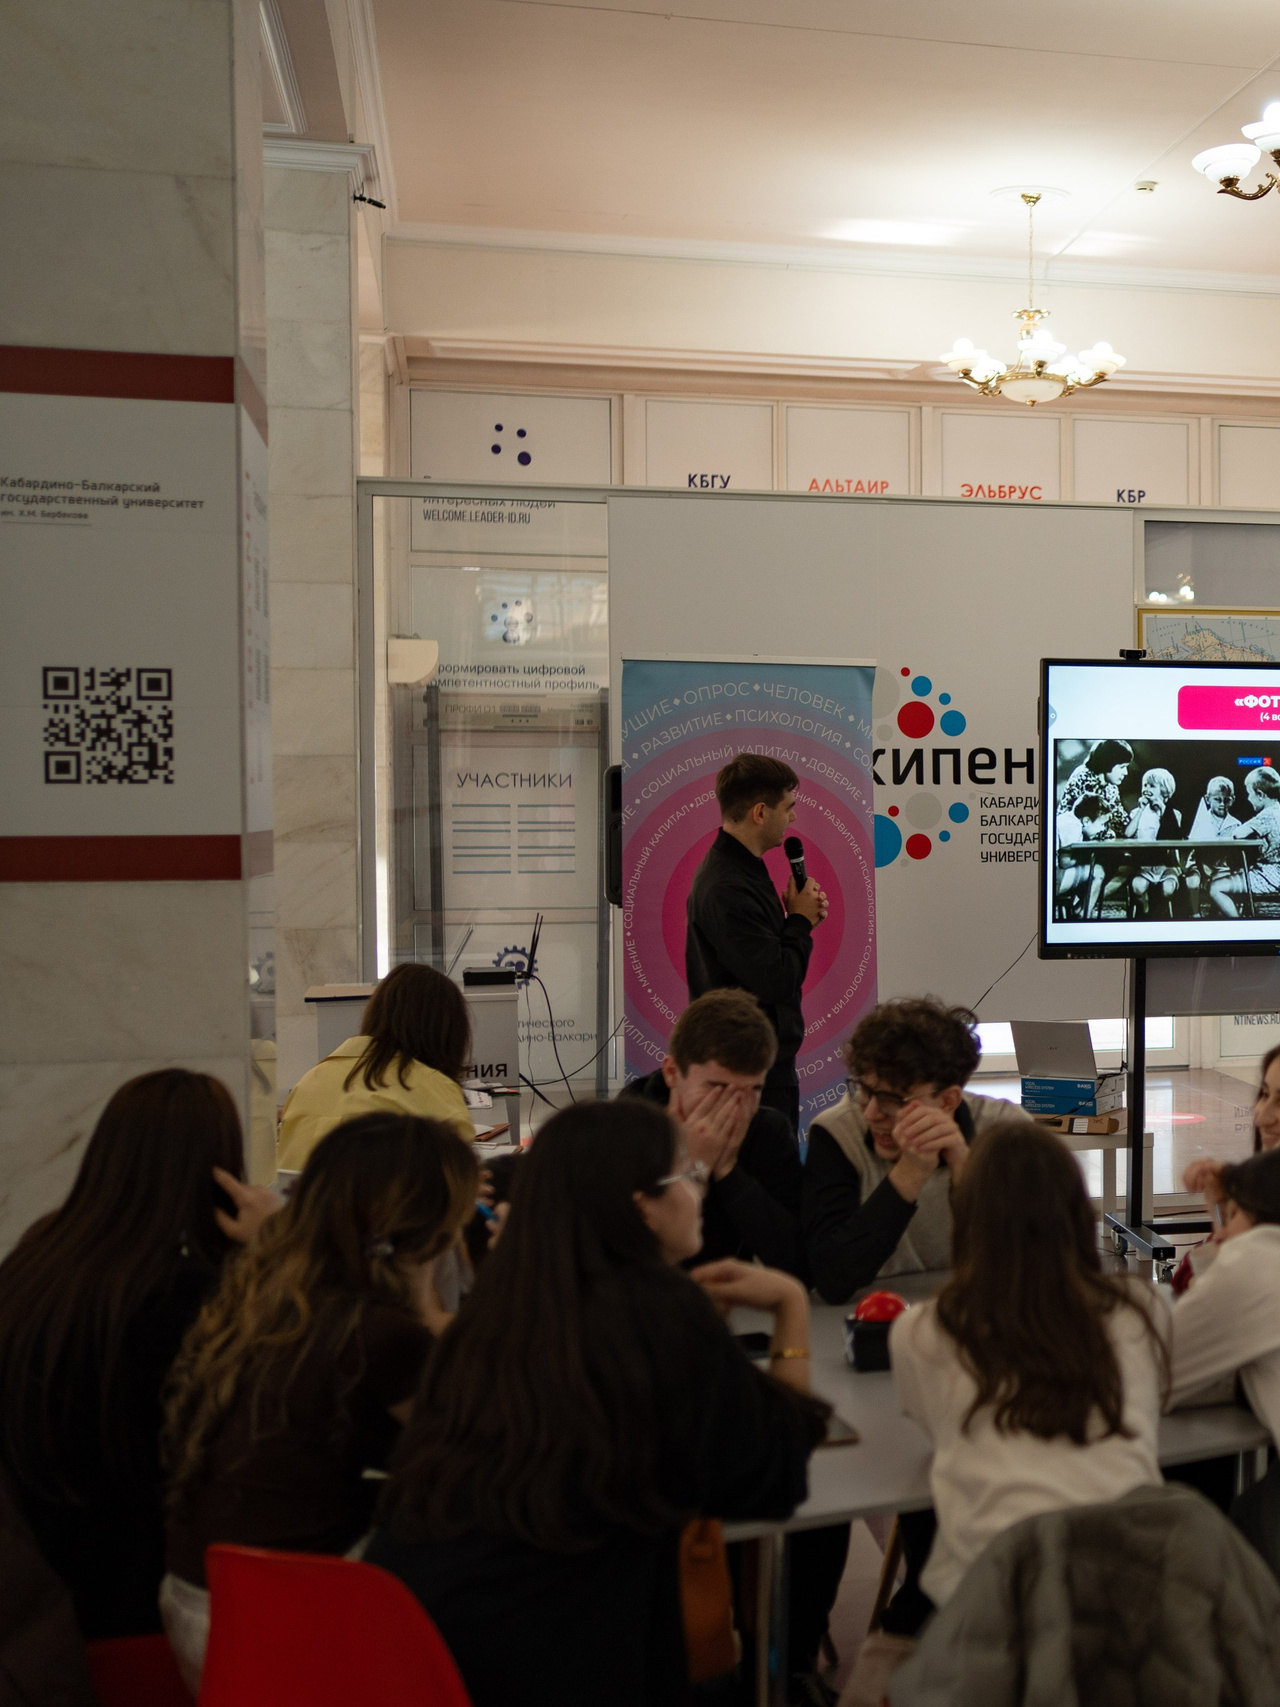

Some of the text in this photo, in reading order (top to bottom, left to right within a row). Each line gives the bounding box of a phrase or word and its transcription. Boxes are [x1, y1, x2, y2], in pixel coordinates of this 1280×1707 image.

[1, 476, 160, 493] Кабардино-Балкарский
[687, 473, 731, 489] КБГУ
[807, 478, 890, 493] АЛЬТАИР
[960, 484, 1043, 500] ЭЛЬБРУС
[1116, 489, 1146, 503] КБР
[1, 492, 204, 509] государственный университет
[423, 509, 531, 524] WELCOME.LEADER-ID.RU
[523, 663, 586, 676] цифровой
[427, 678, 600, 691] омпетентностный профиль
[683, 681, 846, 719] ОПРОС ЧЕЛОВЕК
[1260, 712, 1270, 723] (4
[640, 712, 724, 755] РАЗВИТИЕ
[735, 709, 843, 745] ПСИХОЛОГИЯ
[456, 772, 573, 789] УЧАСТНИКИ
[641, 744, 734, 799] СОЦИАЛЬНЫЙ
[737, 744, 799, 762] КАПИТАЛ
[805, 757, 863, 802] ДОВЕРИЕ
[624, 805, 875, 1015] СОЦИАЛЬНЫЙ КАПИТАЛ РАЗВИТИЕ ПСИХОЛОГИЯ СОЦИОЛОГИЯ
[625, 939, 650, 988] МНЕНИЕ
[1233, 1014, 1280, 1026] NTINEWS.RU
